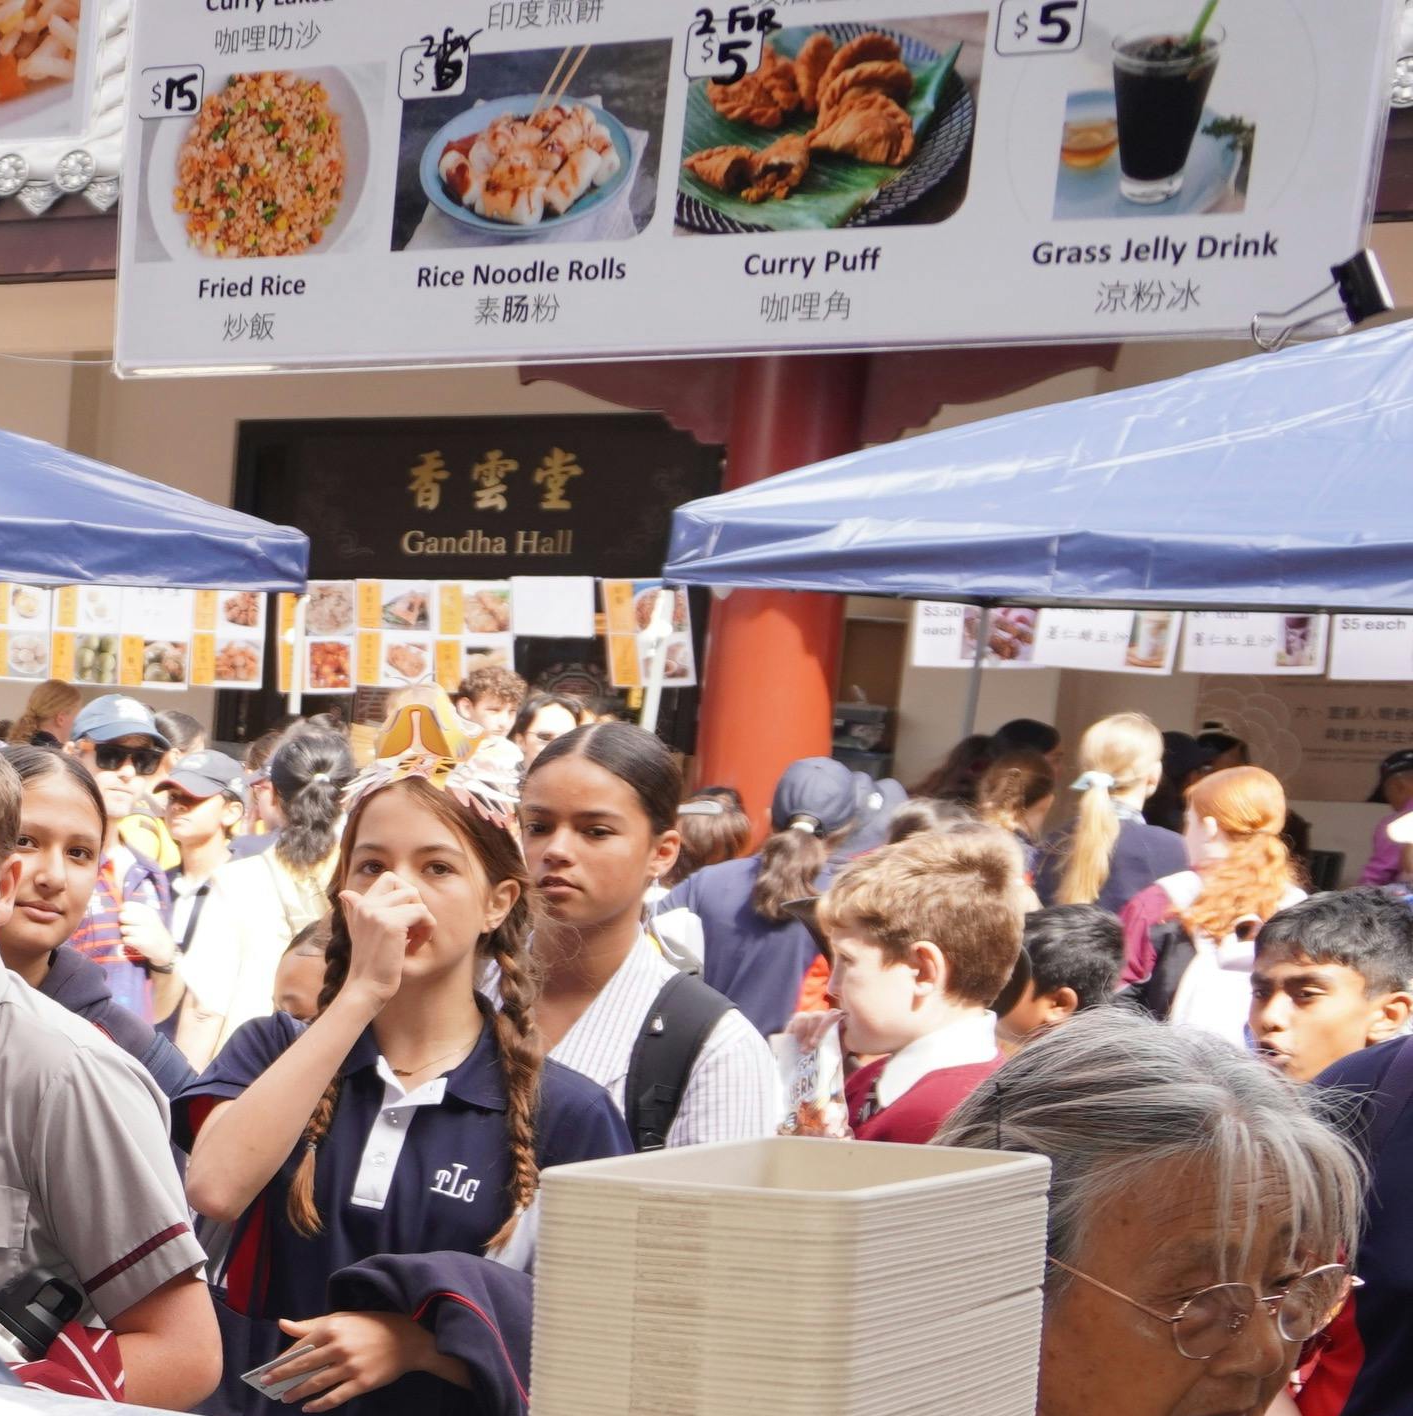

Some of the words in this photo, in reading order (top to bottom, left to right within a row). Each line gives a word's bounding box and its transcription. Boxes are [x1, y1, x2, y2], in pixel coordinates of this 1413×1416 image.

[488, 0, 604, 31] 印度煎餅
[695, 8, 717, 36] 2
[214, 19, 323, 55] 咖哩叻沙
[744, 253, 816, 279] Curry
[823, 247, 883, 272] Puff
[1032, 242, 1112, 267] Grass
[1119, 235, 1186, 267] Jelly
[1196, 231, 1280, 259] Drink
[198, 274, 254, 299] Fried
[260, 274, 307, 297] Rice
[416, 266, 465, 289] Rice
[472, 260, 560, 287] Noodle
[568, 257, 627, 282] Rolls
[475, 293, 561, 325] 素肠粉
[759, 289, 852, 324] 咖哩角
[1095, 277, 1202, 314] 涼粉冰
[222, 312, 276, 342] 炒飯
[407, 446, 584, 512] 香雲堂
[401, 530, 507, 555] Gandha
[515, 530, 573, 555] Hall
[922, 626, 957, 637] each
[1364, 617, 1407, 631] each
